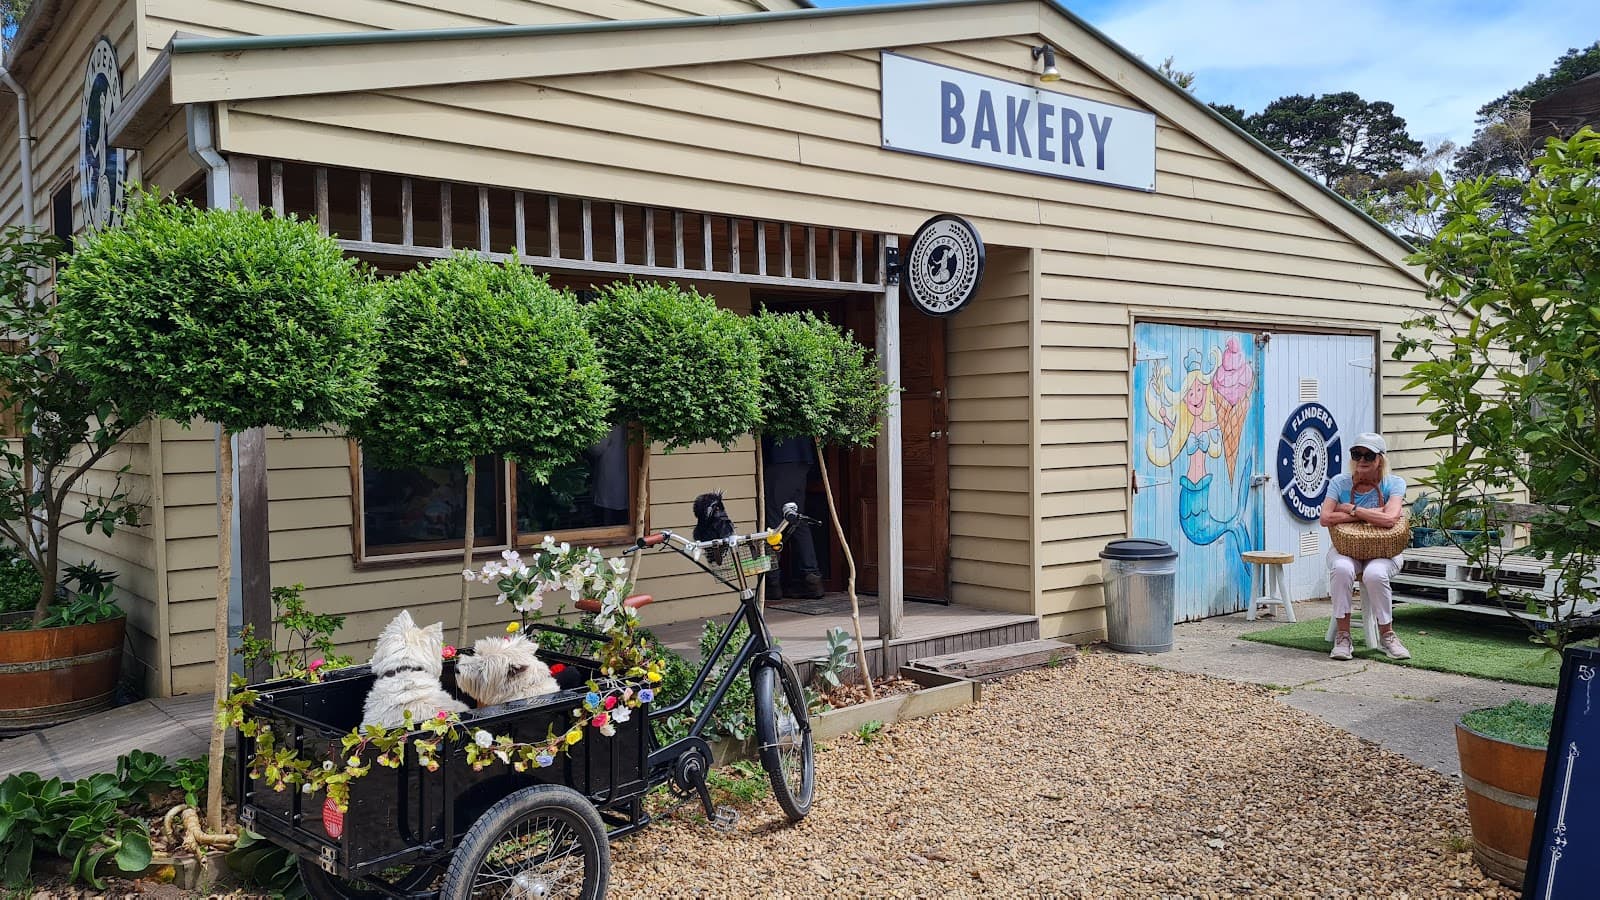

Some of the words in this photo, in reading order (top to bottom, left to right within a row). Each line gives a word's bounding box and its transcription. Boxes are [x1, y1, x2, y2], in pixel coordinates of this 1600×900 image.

[940, 80, 1113, 171] BAKERY
[924, 239, 960, 257] FLINDERS
[923, 267, 963, 292] SOURDOUGH
[1291, 406, 1333, 431] FLINDERS
[1288, 487, 1325, 518] SOURDO
